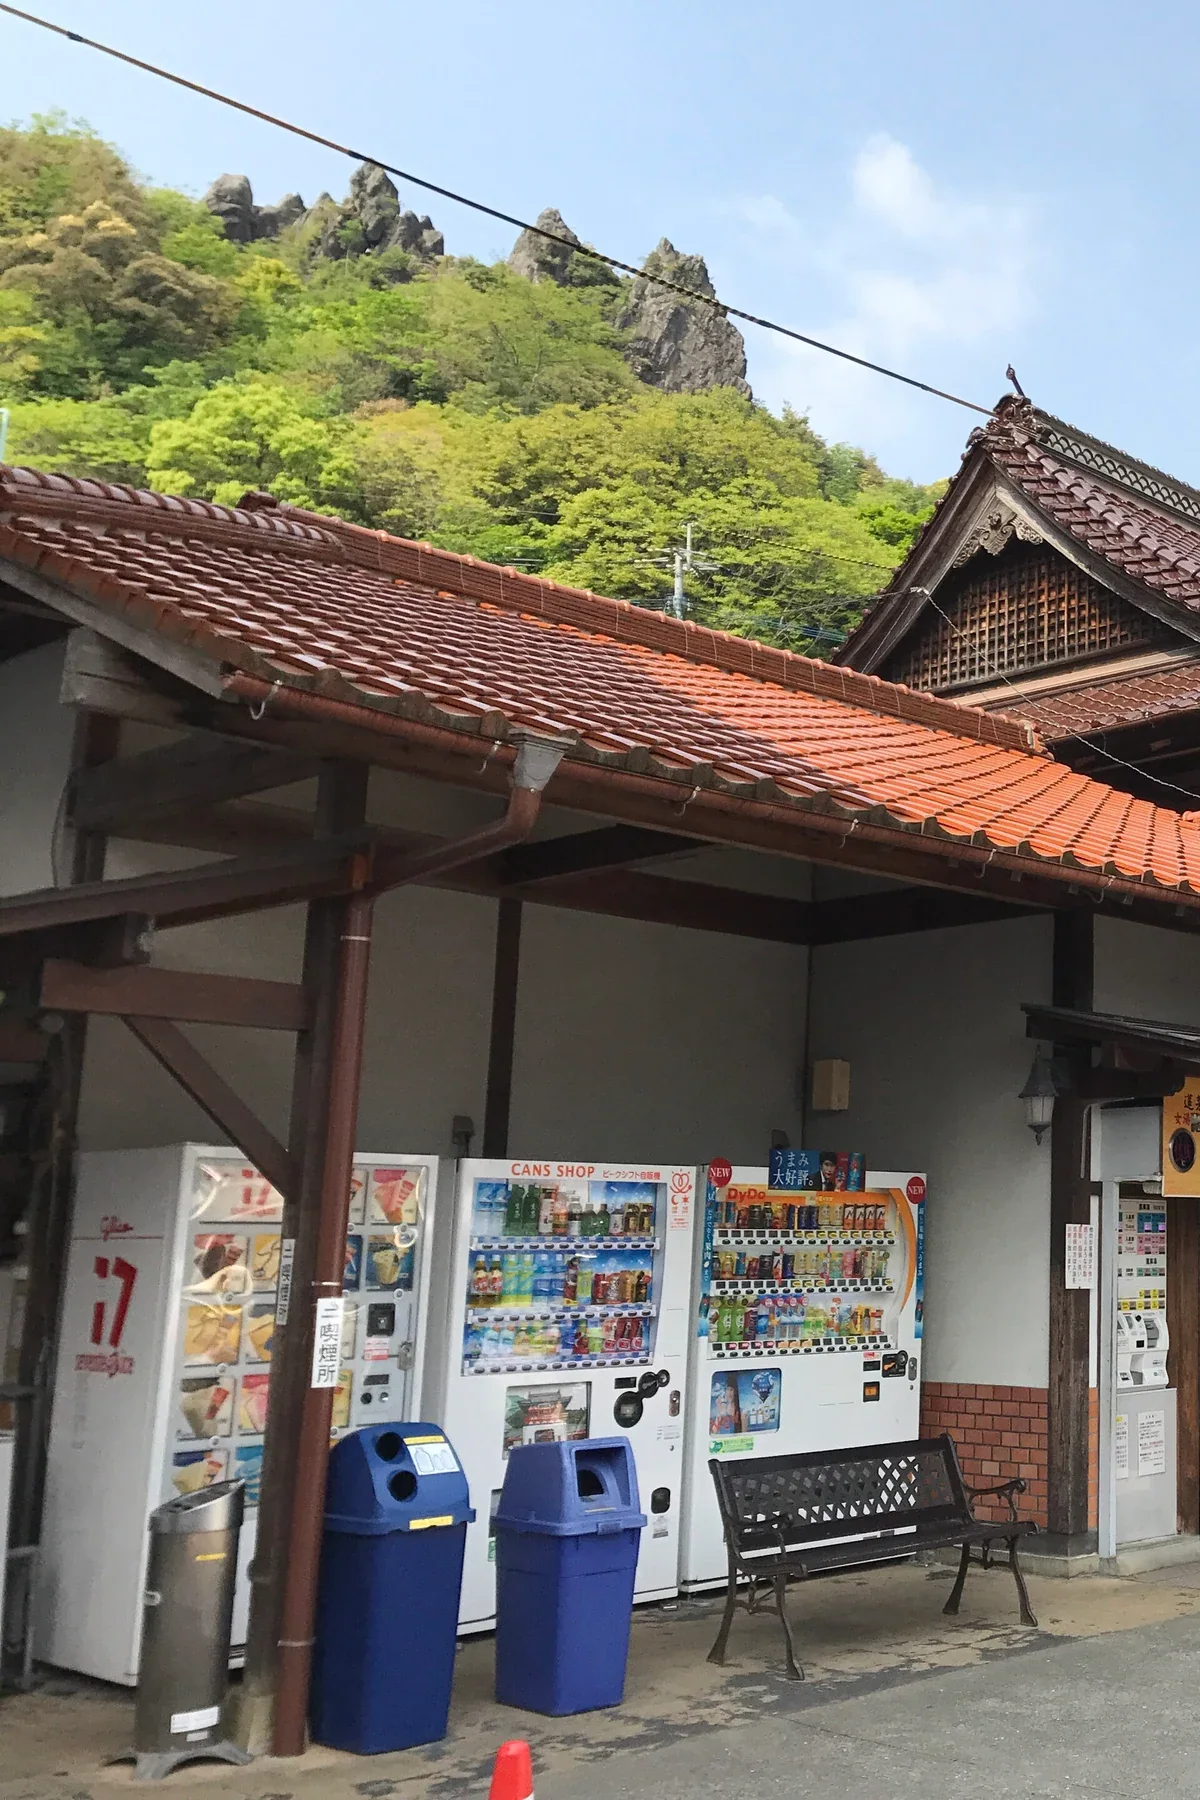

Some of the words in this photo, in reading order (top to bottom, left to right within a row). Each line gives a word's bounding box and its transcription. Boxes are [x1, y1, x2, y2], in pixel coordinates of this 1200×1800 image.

[775, 1151, 809, 1167] うまみ
[511, 1163, 551, 1177] CANS
[557, 1165, 595, 1179] SHOP
[710, 1167, 731, 1179] NEW
[773, 1168, 814, 1187] 大好評。
[727, 1188, 767, 1201] DyDo
[907, 1186, 925, 1195] NEW
[90, 1256, 138, 1348] 17
